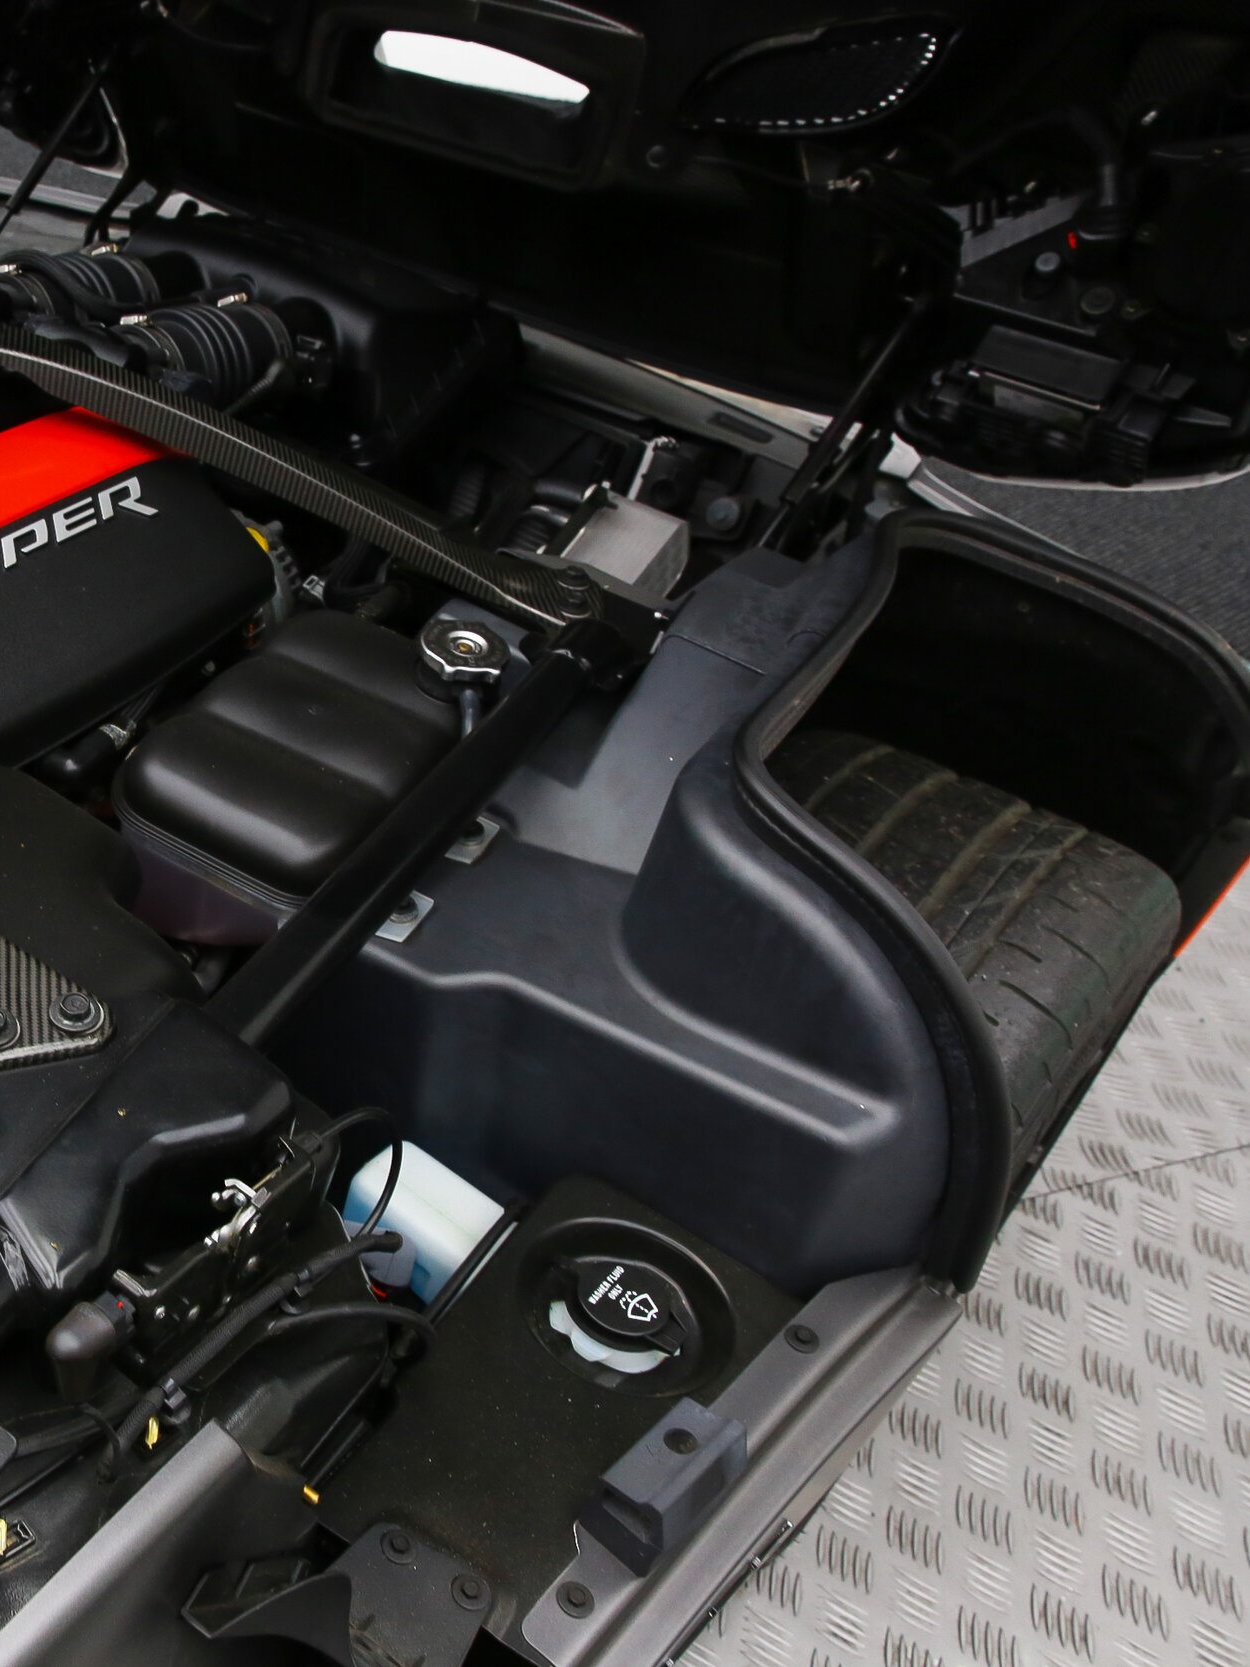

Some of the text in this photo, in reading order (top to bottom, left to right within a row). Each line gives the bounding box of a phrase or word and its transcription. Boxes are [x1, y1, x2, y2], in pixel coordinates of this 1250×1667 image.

[588, 1265, 625, 1305] WASHER FLUID
[607, 1284, 624, 1300] ONLY
